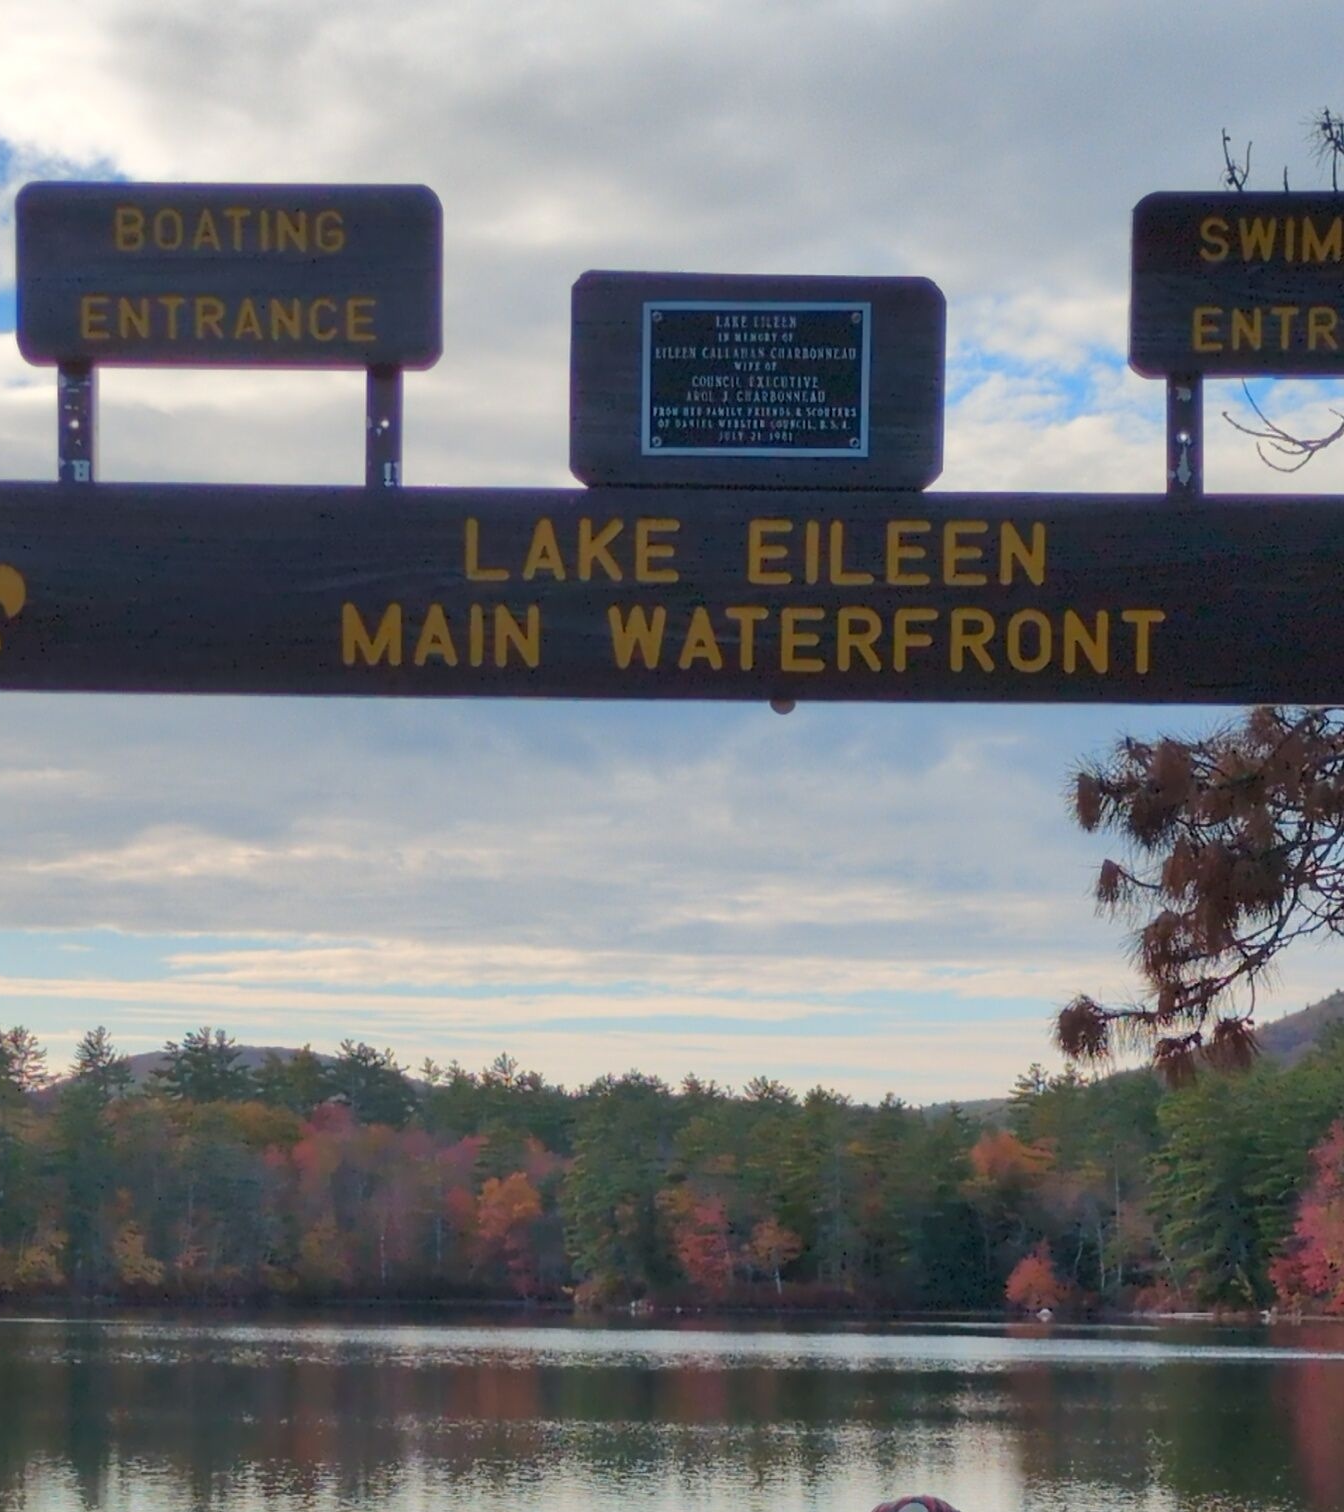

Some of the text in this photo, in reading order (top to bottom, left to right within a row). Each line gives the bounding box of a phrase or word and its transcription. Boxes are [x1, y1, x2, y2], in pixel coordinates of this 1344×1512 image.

[113, 206, 347, 253] BOATING
[80, 294, 378, 342] ENTRANCE
[715, 315, 797, 329] LAKE EILEEN
[718, 332, 794, 343] IN MEMORY OF
[655, 347, 857, 360] EILEEN CALLAHAN CHARBONNEAU
[734, 361, 777, 371] WIFE OF
[691, 375, 819, 389] COUNCIL EXECUTIVE
[736, 390, 826, 403] CHARBONNEAU
[652, 406, 679, 416] FROM
[706, 406, 743, 417] FAMILY
[805, 406, 857, 417] SCOUTERS
[657, 418, 670, 429] OF
[674, 418, 712, 429] DANIEL
[718, 418, 765, 429] WEBSTER
[718, 430, 744, 442] JULY
[465, 517, 1047, 588] LAKE EILEEN
[341, 602, 1166, 675] MAIN WATERFRONT
